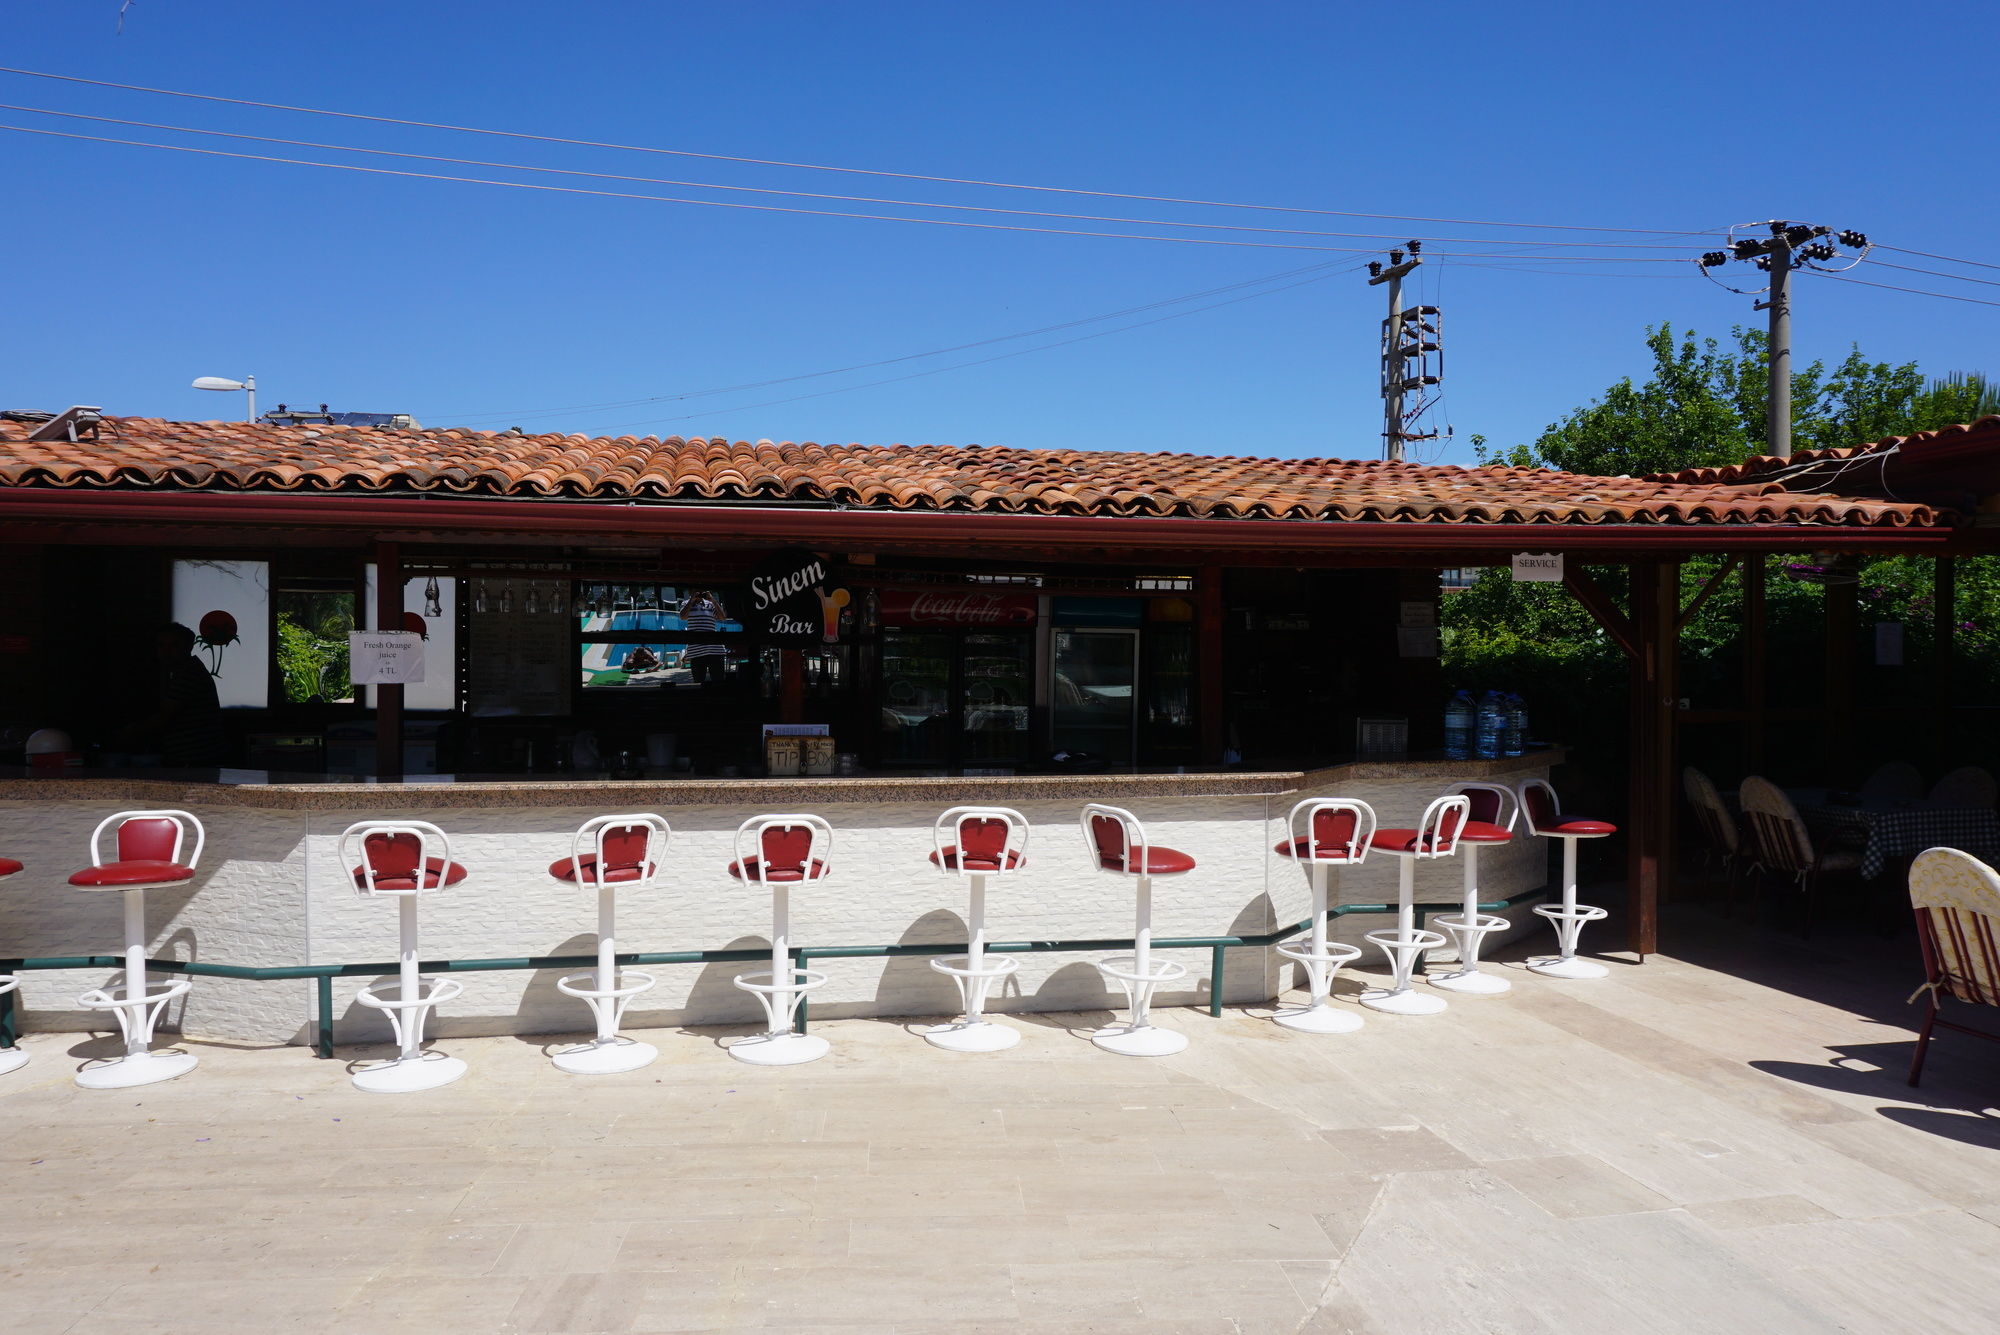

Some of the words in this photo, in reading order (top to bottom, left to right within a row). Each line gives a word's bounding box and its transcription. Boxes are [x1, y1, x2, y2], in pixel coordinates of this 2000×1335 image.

[1519, 559, 1557, 568] SERVICE
[752, 561, 826, 610] Sinem
[910, 591, 1007, 623] Coca-Cola
[769, 613, 815, 634] Bar
[363, 641, 384, 649] Fresh
[385, 641, 412, 651] Orange
[384, 667, 397, 675] TL
[774, 749, 799, 767] TIP
[807, 750, 832, 767] BOX
